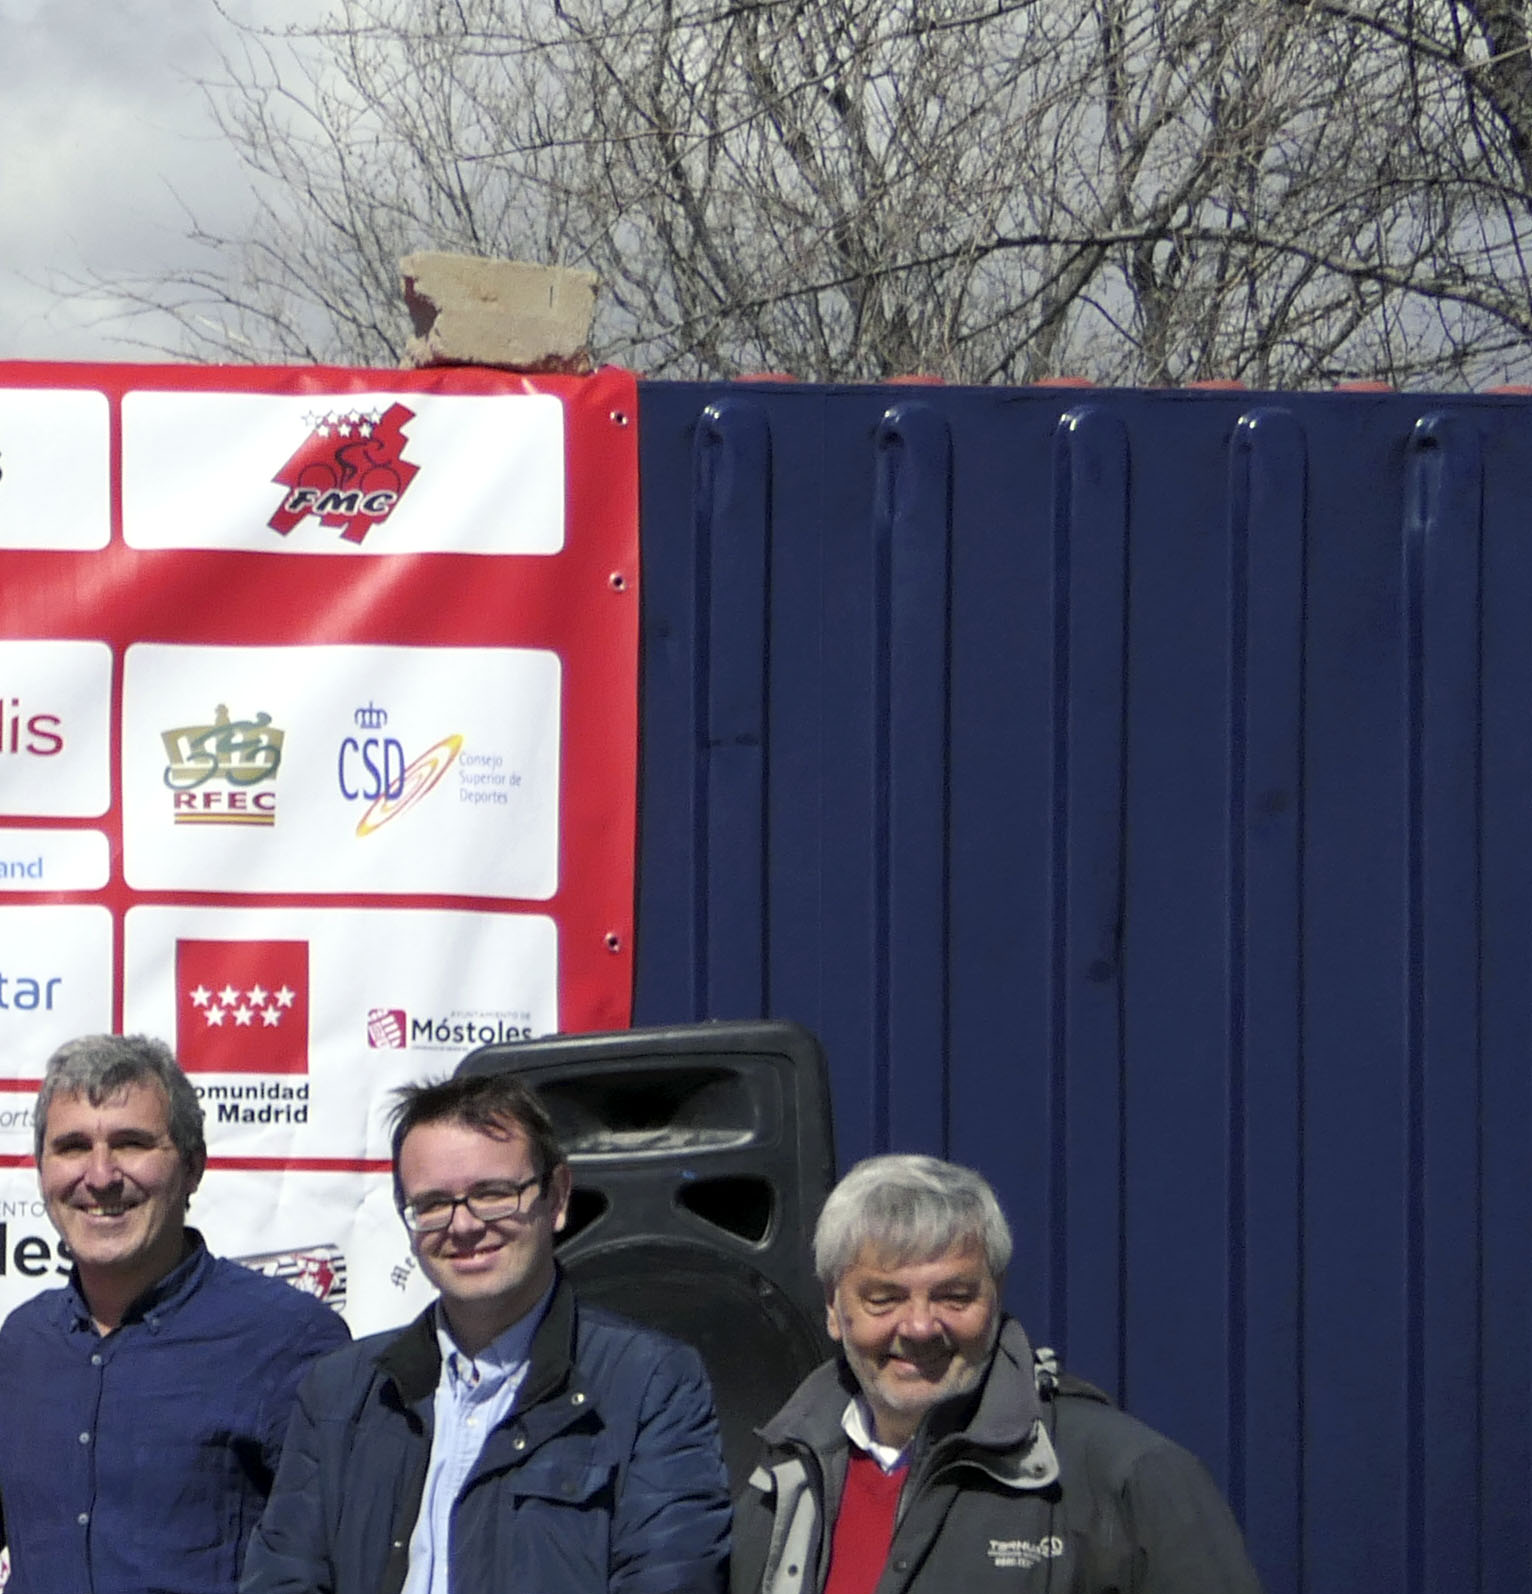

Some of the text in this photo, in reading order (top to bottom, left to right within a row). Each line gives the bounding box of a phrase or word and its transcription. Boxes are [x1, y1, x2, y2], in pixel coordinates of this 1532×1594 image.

[286, 486, 398, 515] FMC
[337, 736, 406, 802] CSD
[458, 752, 504, 769] Consejo
[458, 770, 522, 788] Superior de
[173, 791, 277, 811] RFEC
[458, 788, 509, 806] Deportes
[193, 1082, 310, 1101] omunidad
[217, 1103, 309, 1124] Madrid
